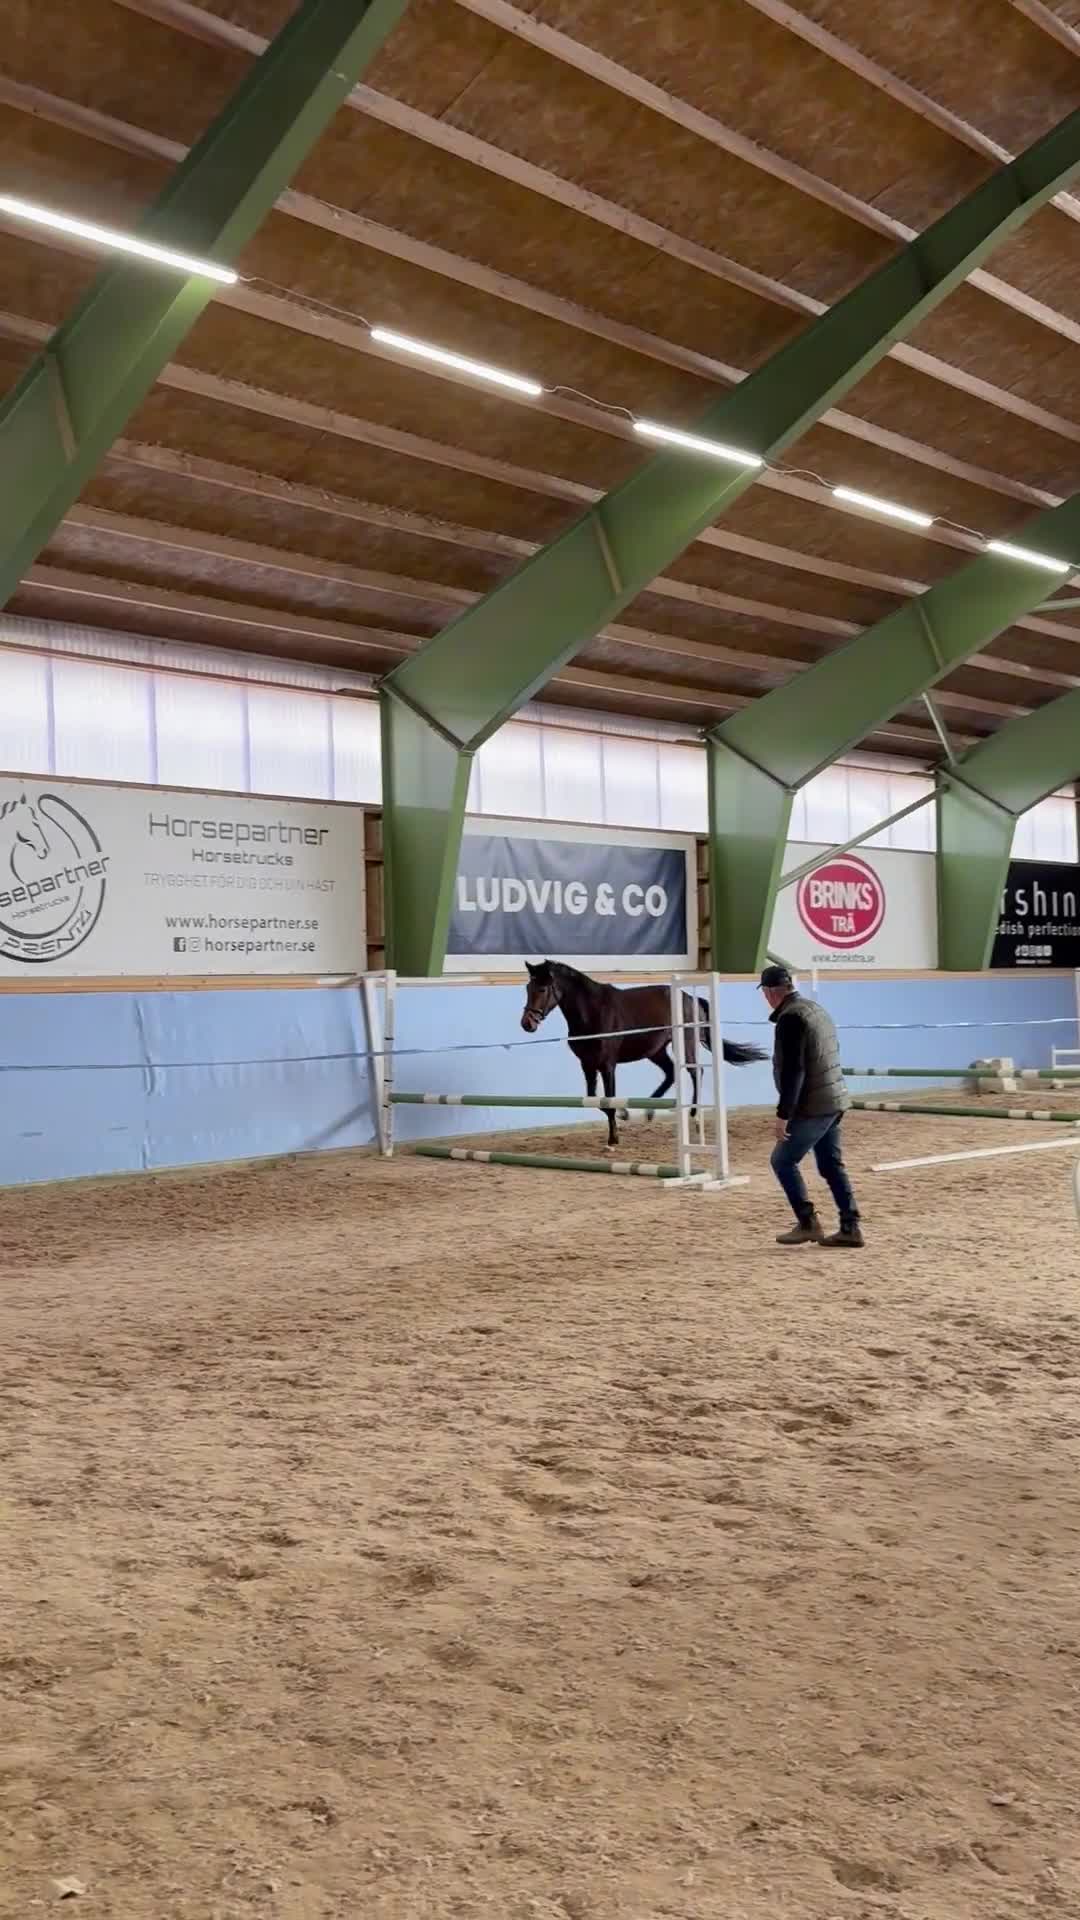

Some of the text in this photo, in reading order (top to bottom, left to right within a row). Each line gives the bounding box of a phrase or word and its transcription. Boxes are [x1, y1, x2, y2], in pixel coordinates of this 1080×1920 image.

[149, 812, 330, 847] Horsepartner
[192, 848, 295, 867] Horsetrucks
[144, 872, 208, 888] TRYGGHET
[457, 876, 668, 917] LUDVIG & CO
[810, 881, 873, 911] BRINKS
[165, 914, 319, 931] www.horsepartner.se
[205, 937, 316, 954] horsepartner.se
